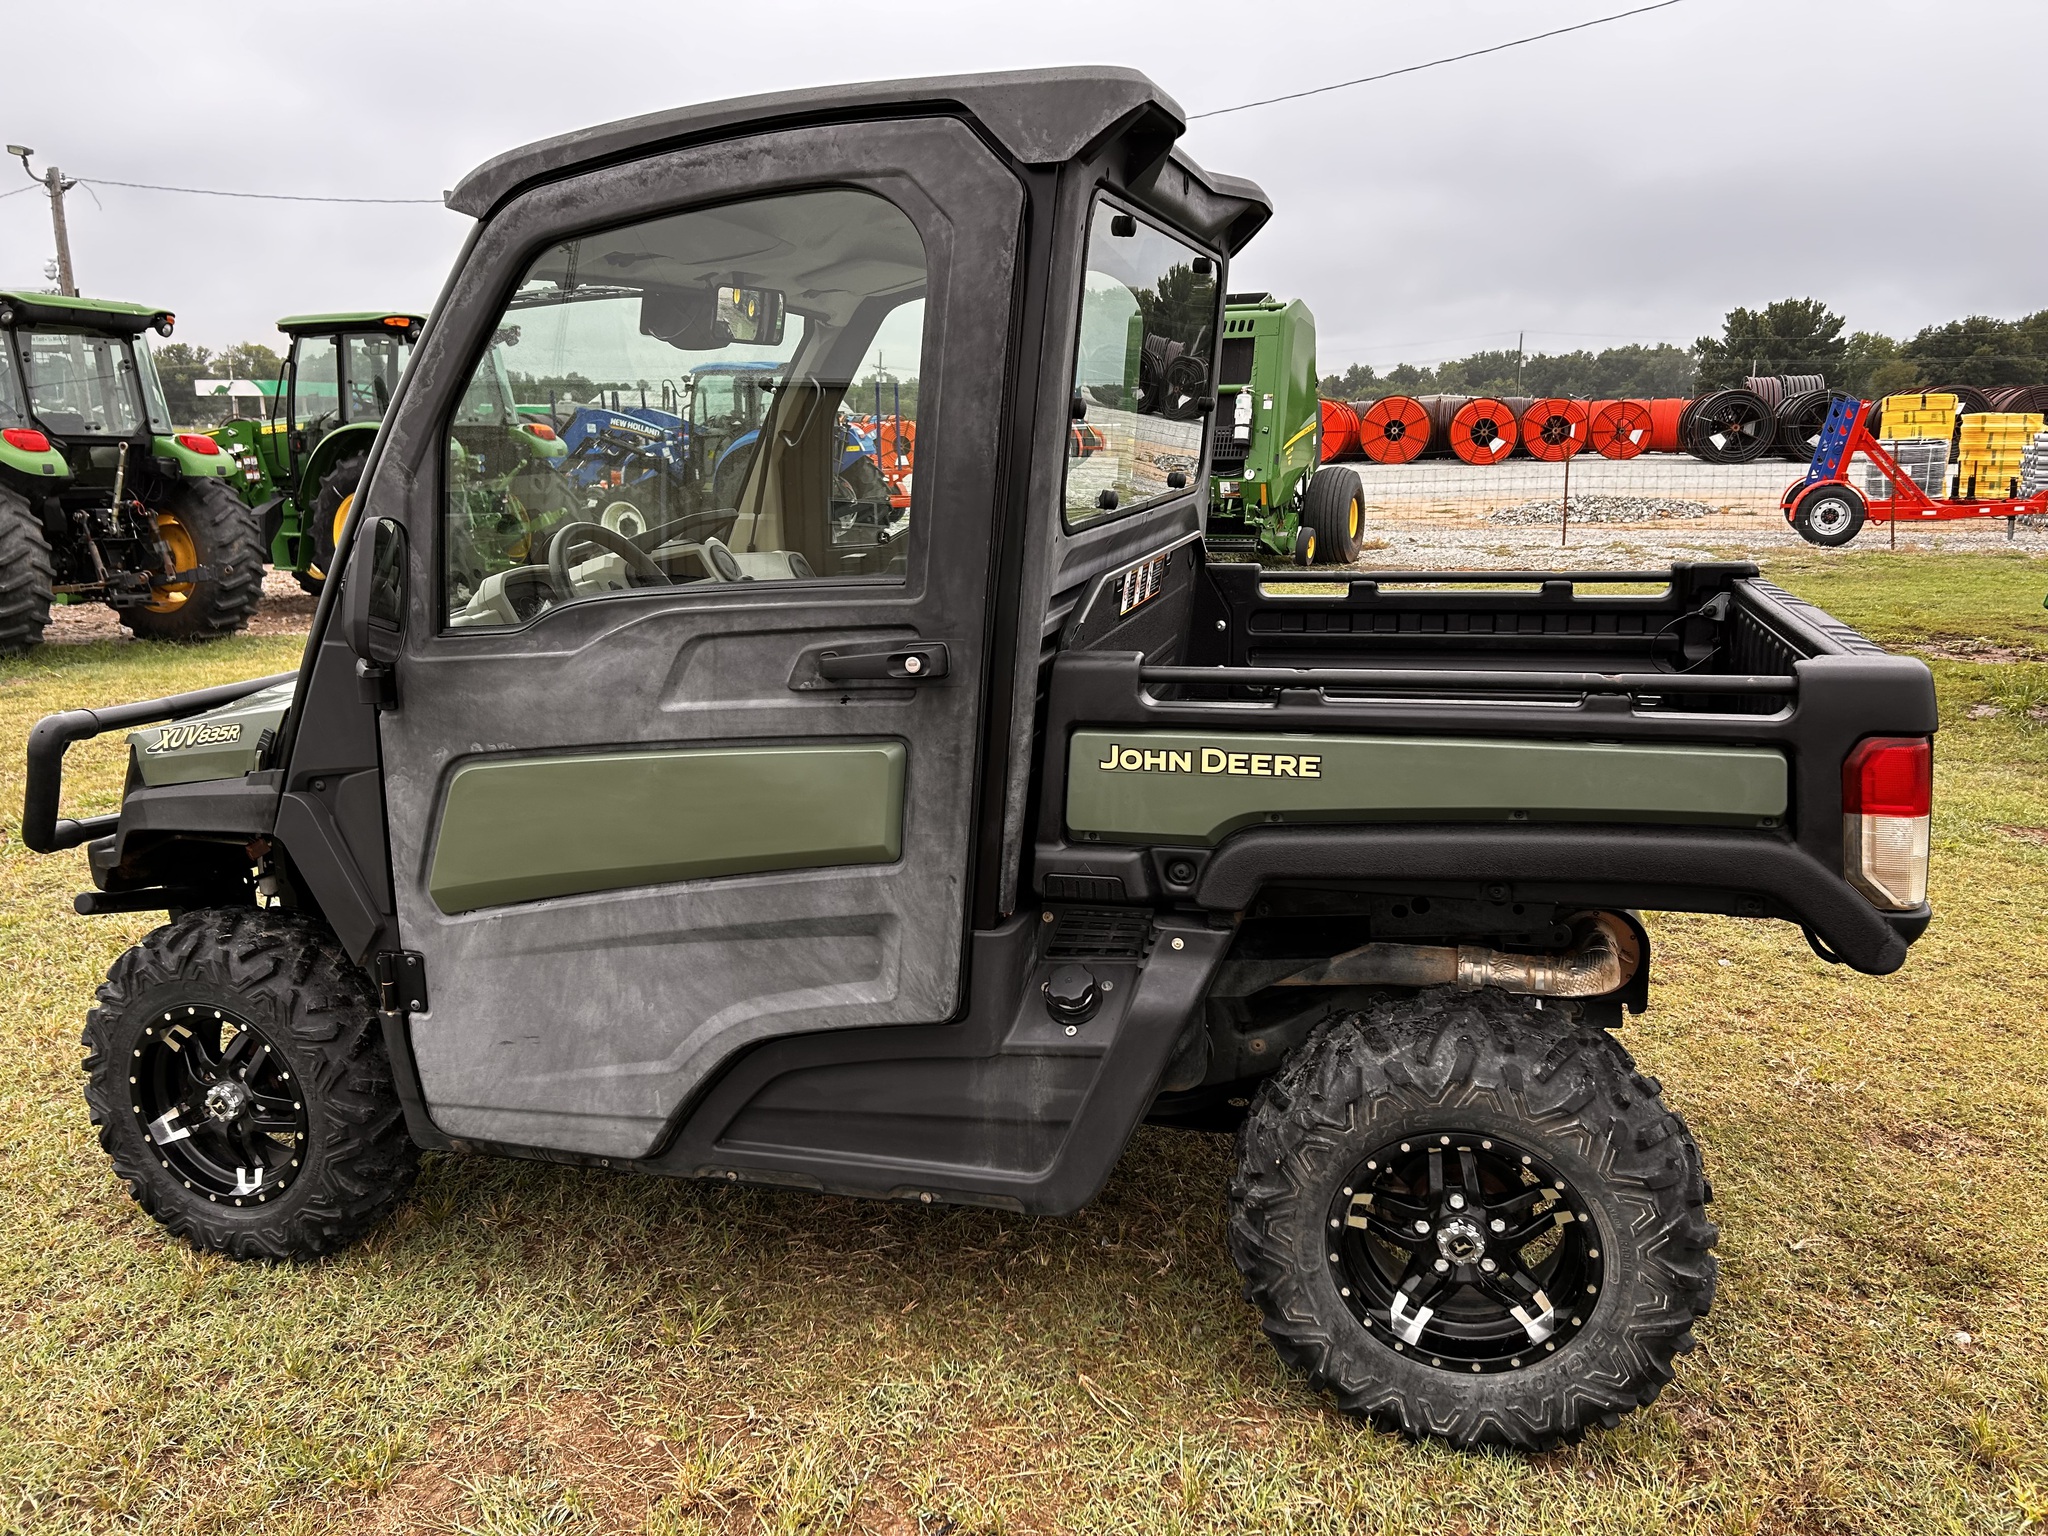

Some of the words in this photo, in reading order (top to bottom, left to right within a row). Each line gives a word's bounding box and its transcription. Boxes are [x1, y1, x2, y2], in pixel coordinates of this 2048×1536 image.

[610, 417, 626, 428] NEW
[627, 421, 660, 436] HOLLAND
[147, 723, 241, 753] XUV835R
[1099, 744, 1192, 773] JOHN
[1200, 747, 1322, 778] DEERE
